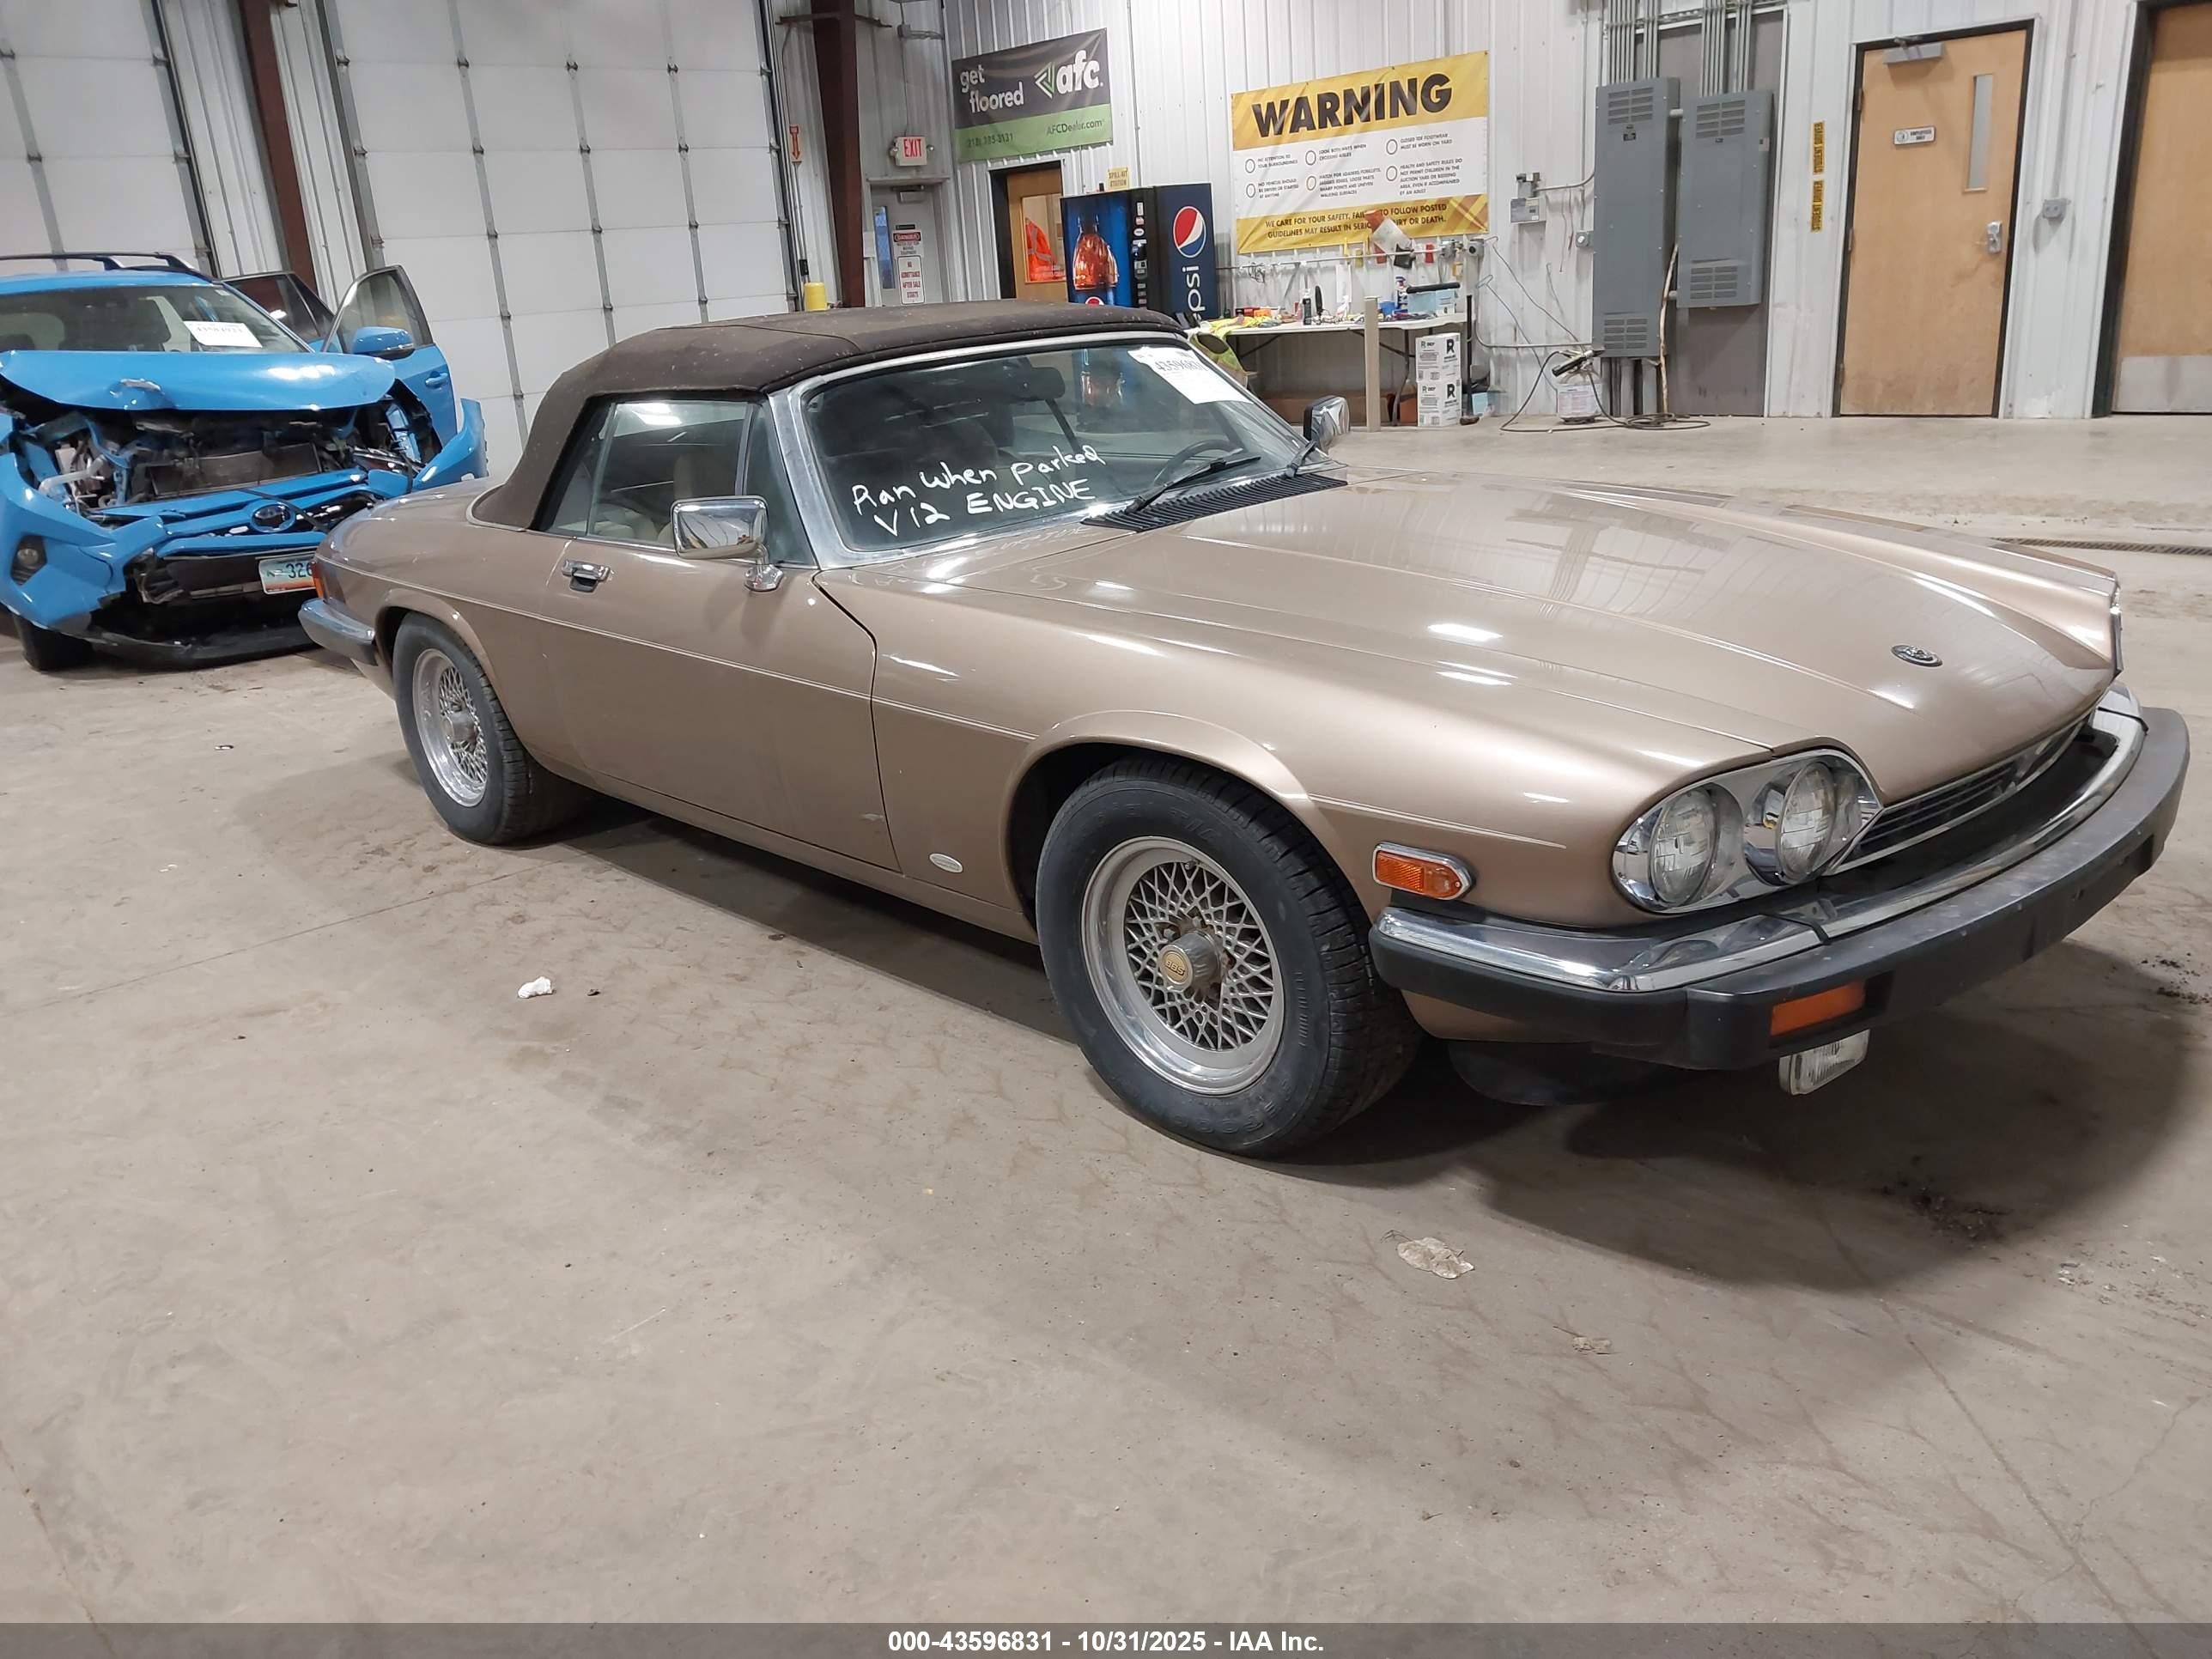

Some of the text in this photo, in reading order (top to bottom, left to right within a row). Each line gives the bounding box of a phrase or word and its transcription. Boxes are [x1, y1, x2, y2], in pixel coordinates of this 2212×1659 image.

[960, 64, 985, 93] get
[969, 82, 1024, 113] floored
[1252, 73, 1453, 138] WARNING
[904, 139, 921, 157] EXIT
[1276, 219, 1292, 227] CARE
[1308, 216, 1325, 224] YOUR
[1391, 207, 1419, 215] FOLLOW
[1420, 204, 1447, 213] POSTED
[1267, 228, 1302, 239] GUIDELINES
[1319, 225, 1342, 234] RESULT
[1446, 339, 1454, 354] R
[1447, 384, 1455, 399] R
[852, 484, 916, 515] Ran
[1011, 445, 1106, 486] Parked
[966, 479, 1096, 514] ENGINE
[1165, 961, 1185, 976] BBS
